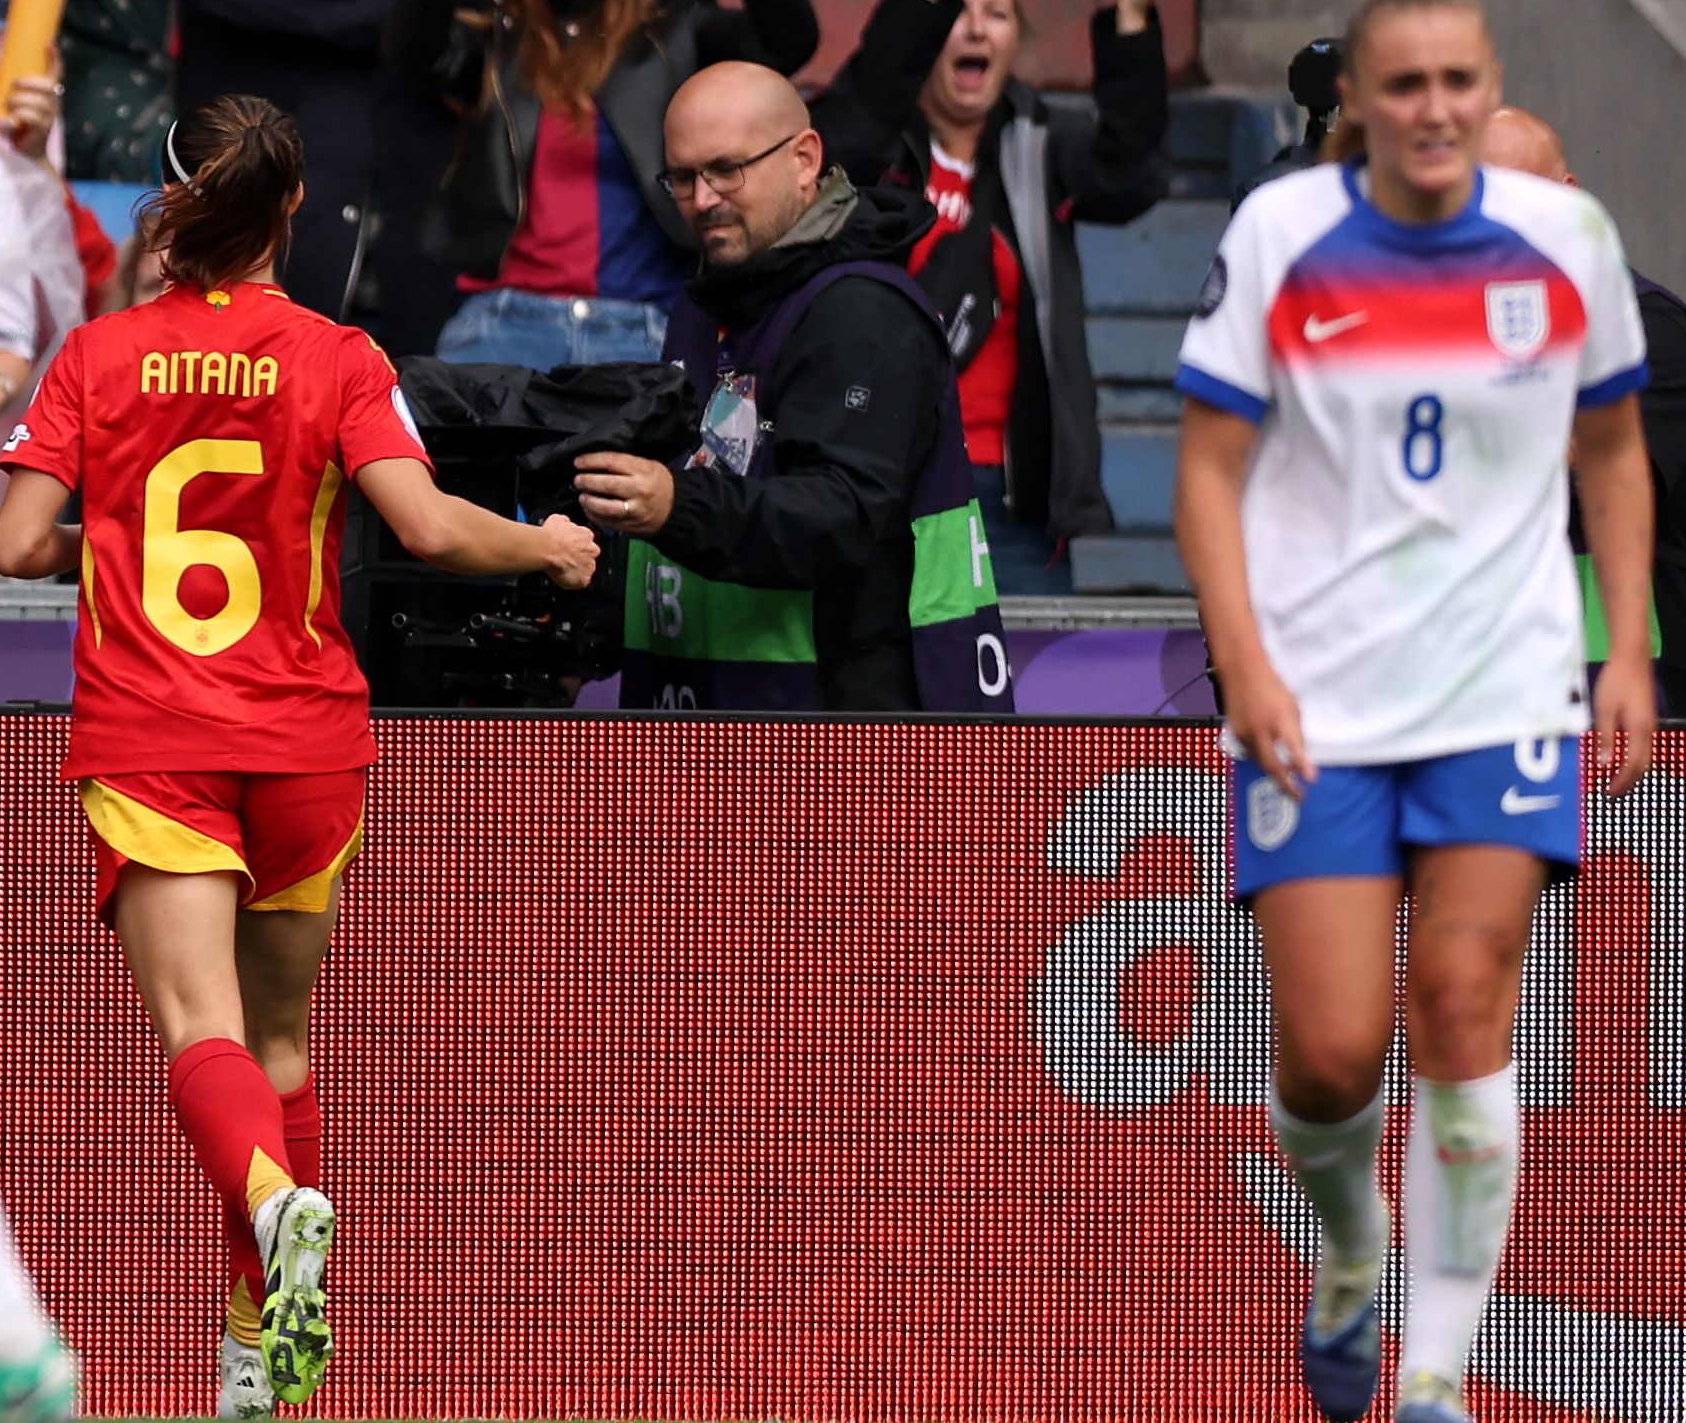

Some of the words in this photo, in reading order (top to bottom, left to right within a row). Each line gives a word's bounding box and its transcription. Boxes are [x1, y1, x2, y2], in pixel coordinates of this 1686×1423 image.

[140, 351, 279, 398] AITANA
[1402, 392, 1444, 483] 8
[141, 437, 265, 658] 6
